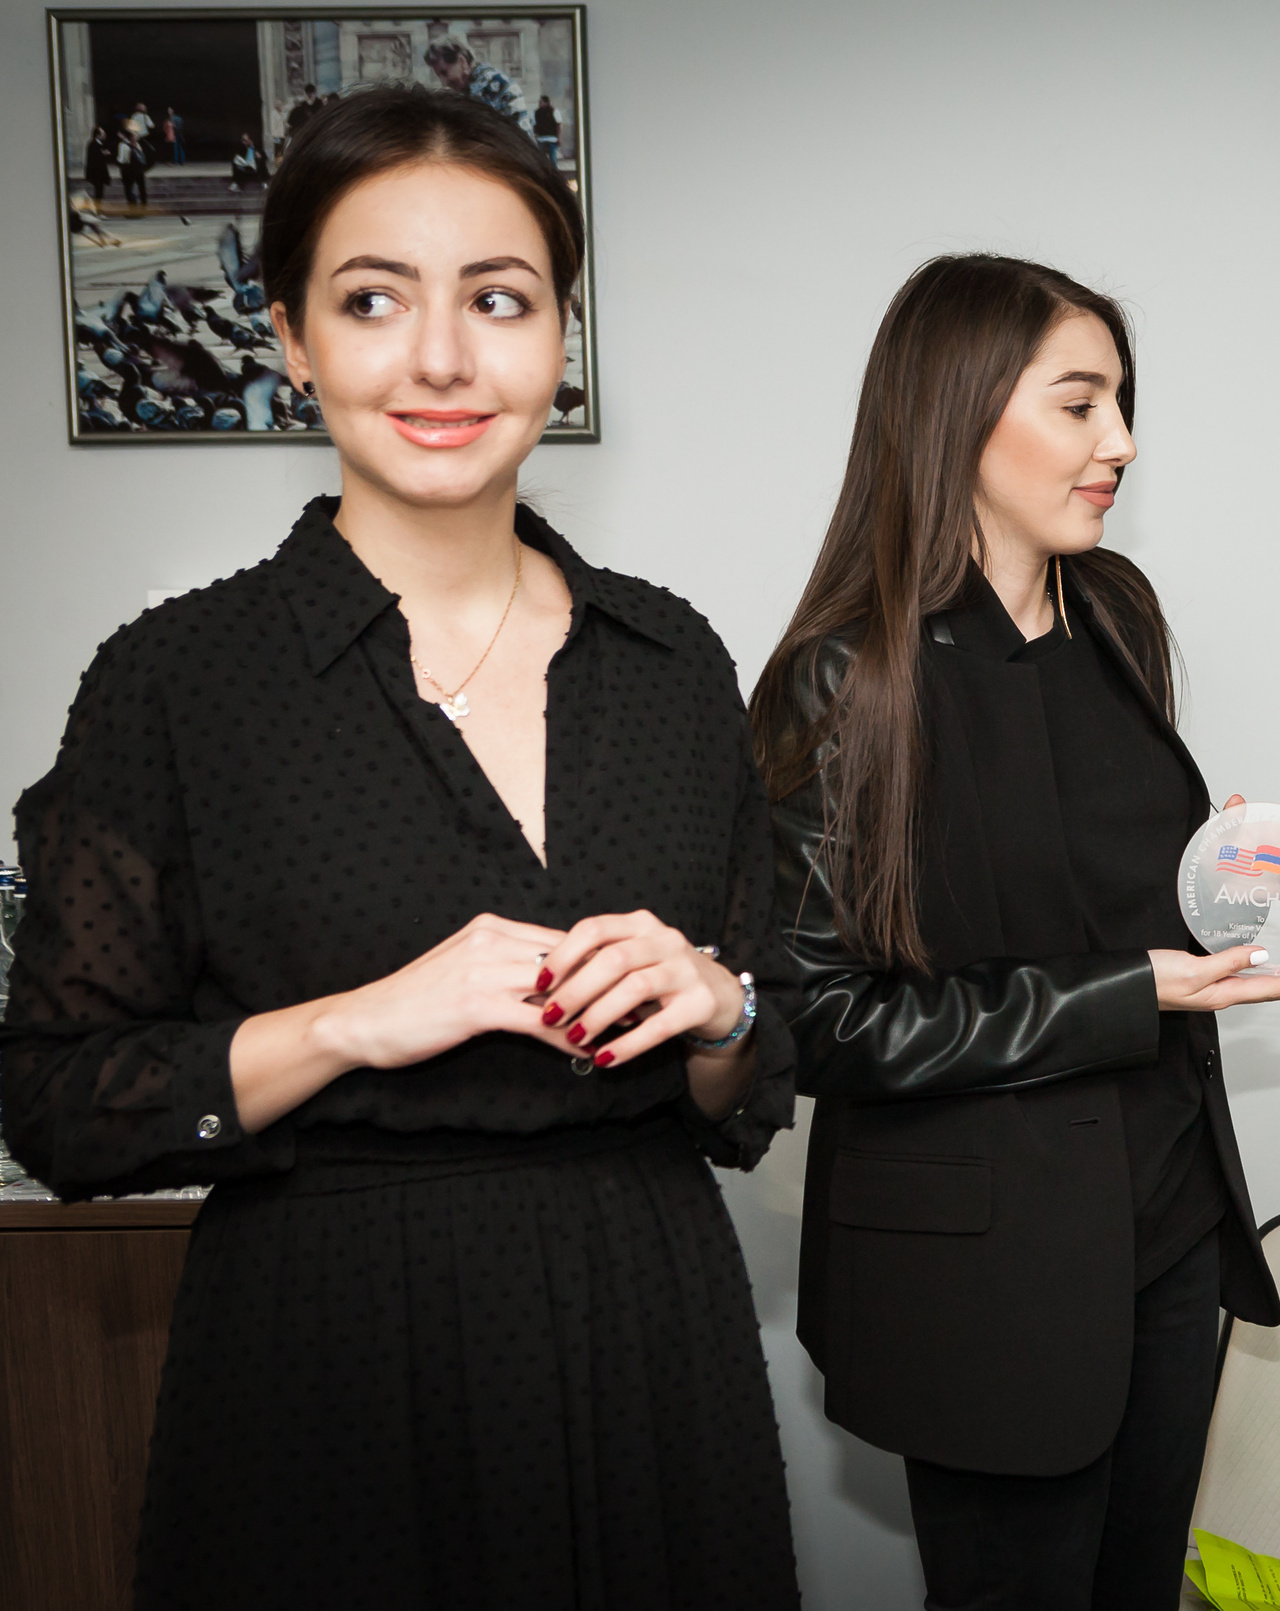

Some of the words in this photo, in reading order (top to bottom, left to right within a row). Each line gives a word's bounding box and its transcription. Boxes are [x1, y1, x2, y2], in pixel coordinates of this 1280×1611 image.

[1186, 855, 1201, 917] AMERICAN
[1198, 815, 1245, 852] CHAMBER
[1256, 915, 1265, 923] To
[1228, 922, 1255, 931] Kristine
[1200, 929, 1211, 937] for
[1241, 931, 1250, 939] of
